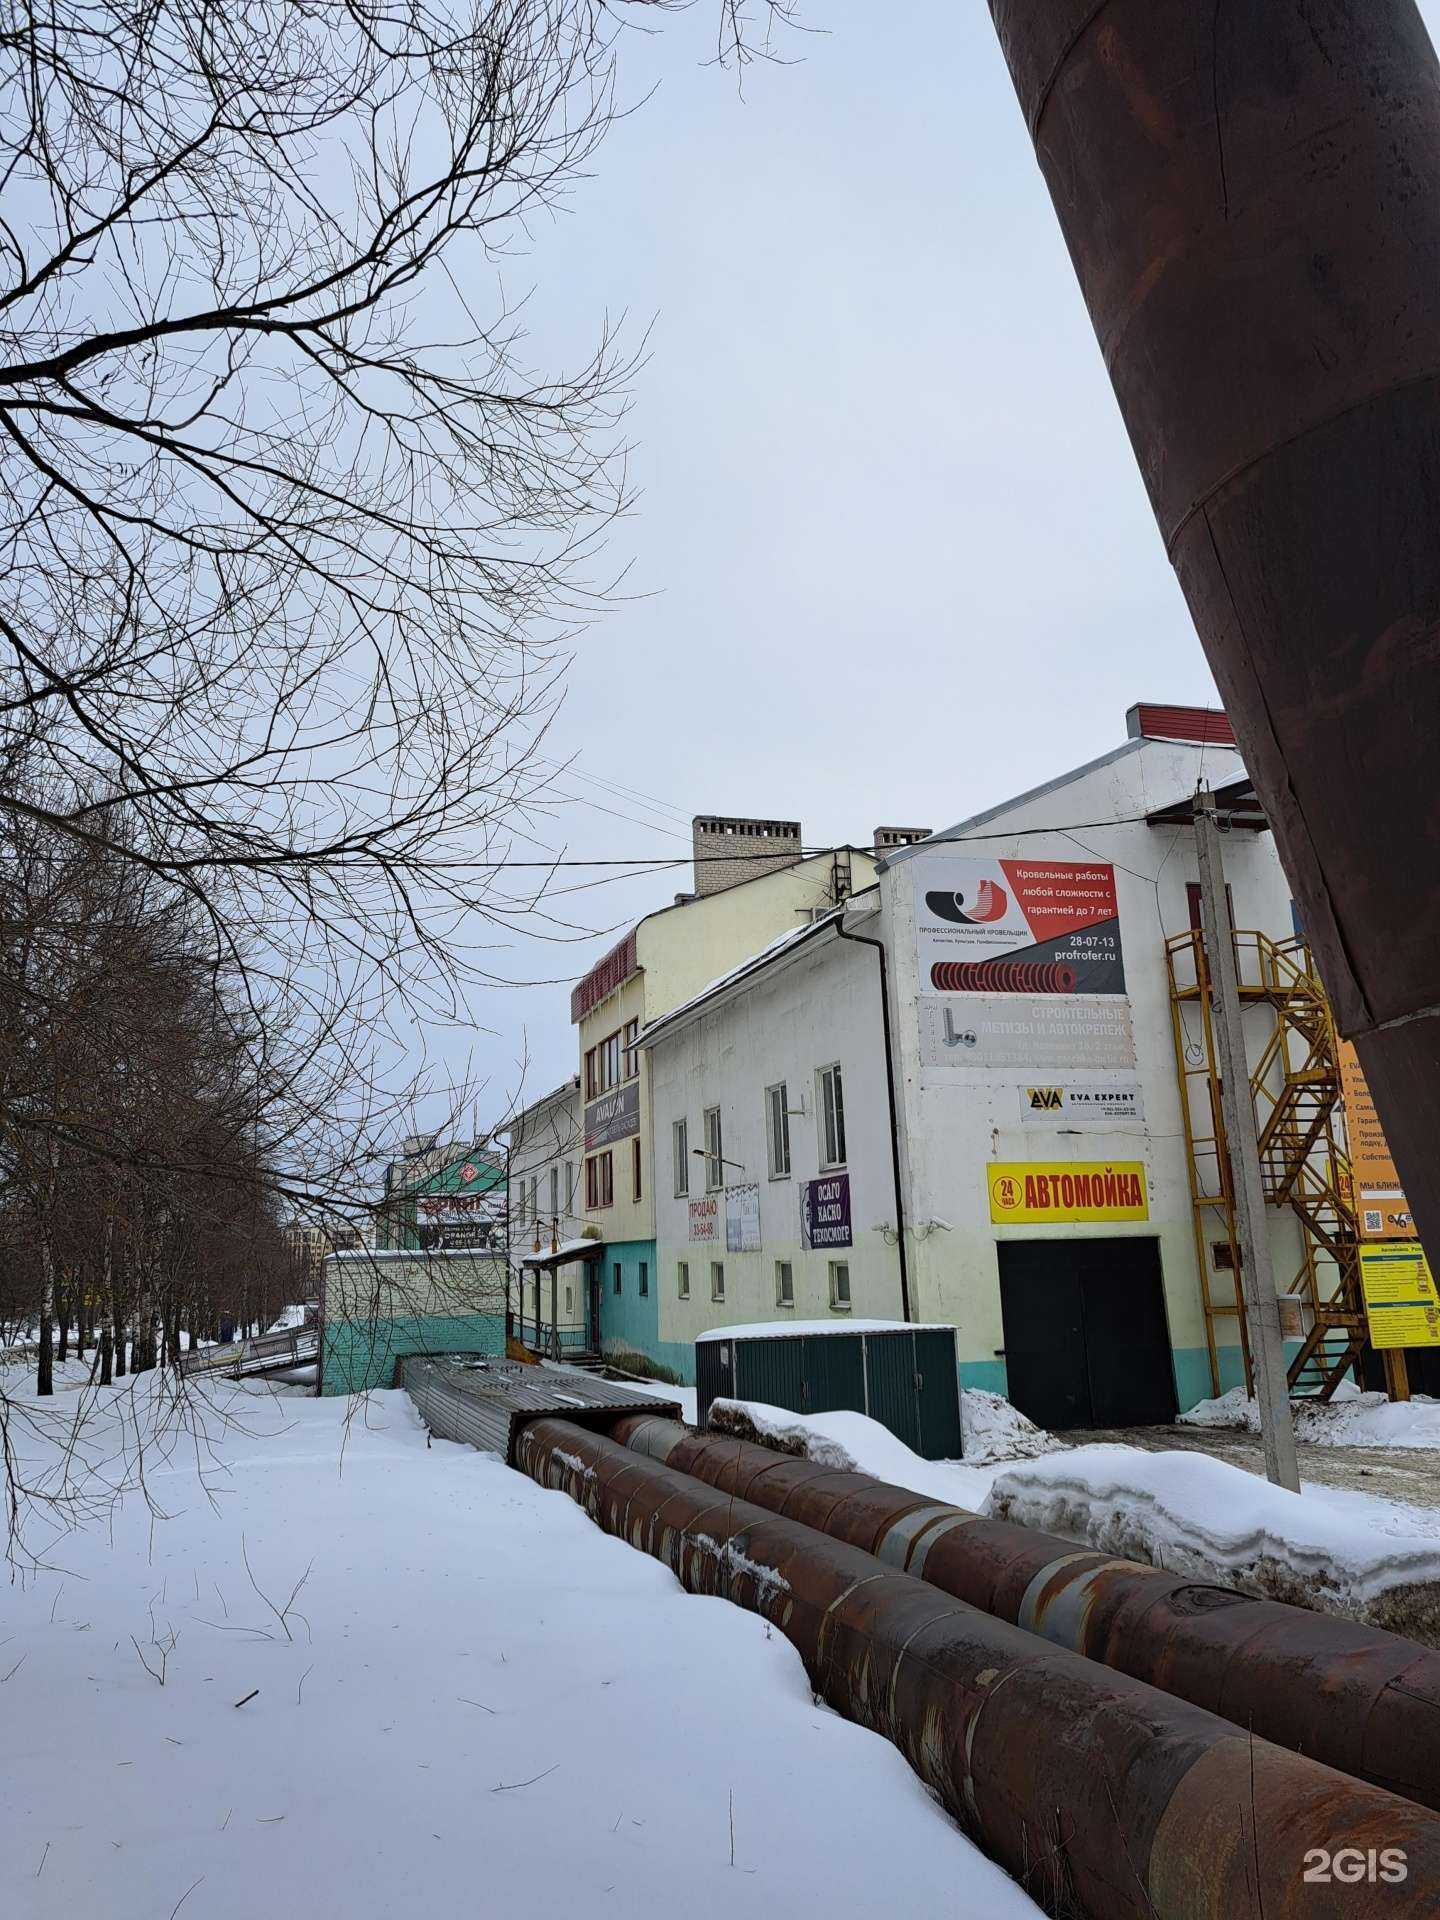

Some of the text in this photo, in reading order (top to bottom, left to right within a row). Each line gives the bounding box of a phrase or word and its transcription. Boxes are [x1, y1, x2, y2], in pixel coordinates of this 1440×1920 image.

[1016, 868, 1108, 881] Кровельные работы
[1022, 887, 1053, 897] любой
[1056, 890, 1104, 898] сложности
[1027, 906, 1074, 915] гарантией
[1076, 908, 1088, 916] до
[1090, 906, 1095, 914] 7
[1070, 936, 1114, 947] 28-07-13
[1054, 950, 1116, 961] profrofer.ru
[1032, 1007, 1124, 1020] СТРОИТЕЛЬНЫЕ
[981, 1022, 1128, 1036] МЕТИЗЫ И АВТОКРЕПЕЖ
[818, 1182, 840, 1202] ОСАГО
[1001, 1180, 1014, 1196] 24
[1025, 1167, 1143, 1208] АВТОМОЙКА
[690, 1200, 716, 1218] ПРОДАЮ
[818, 1204, 842, 1222] КАСКО
[813, 1225, 850, 1243] ТЕХОСМОТР
